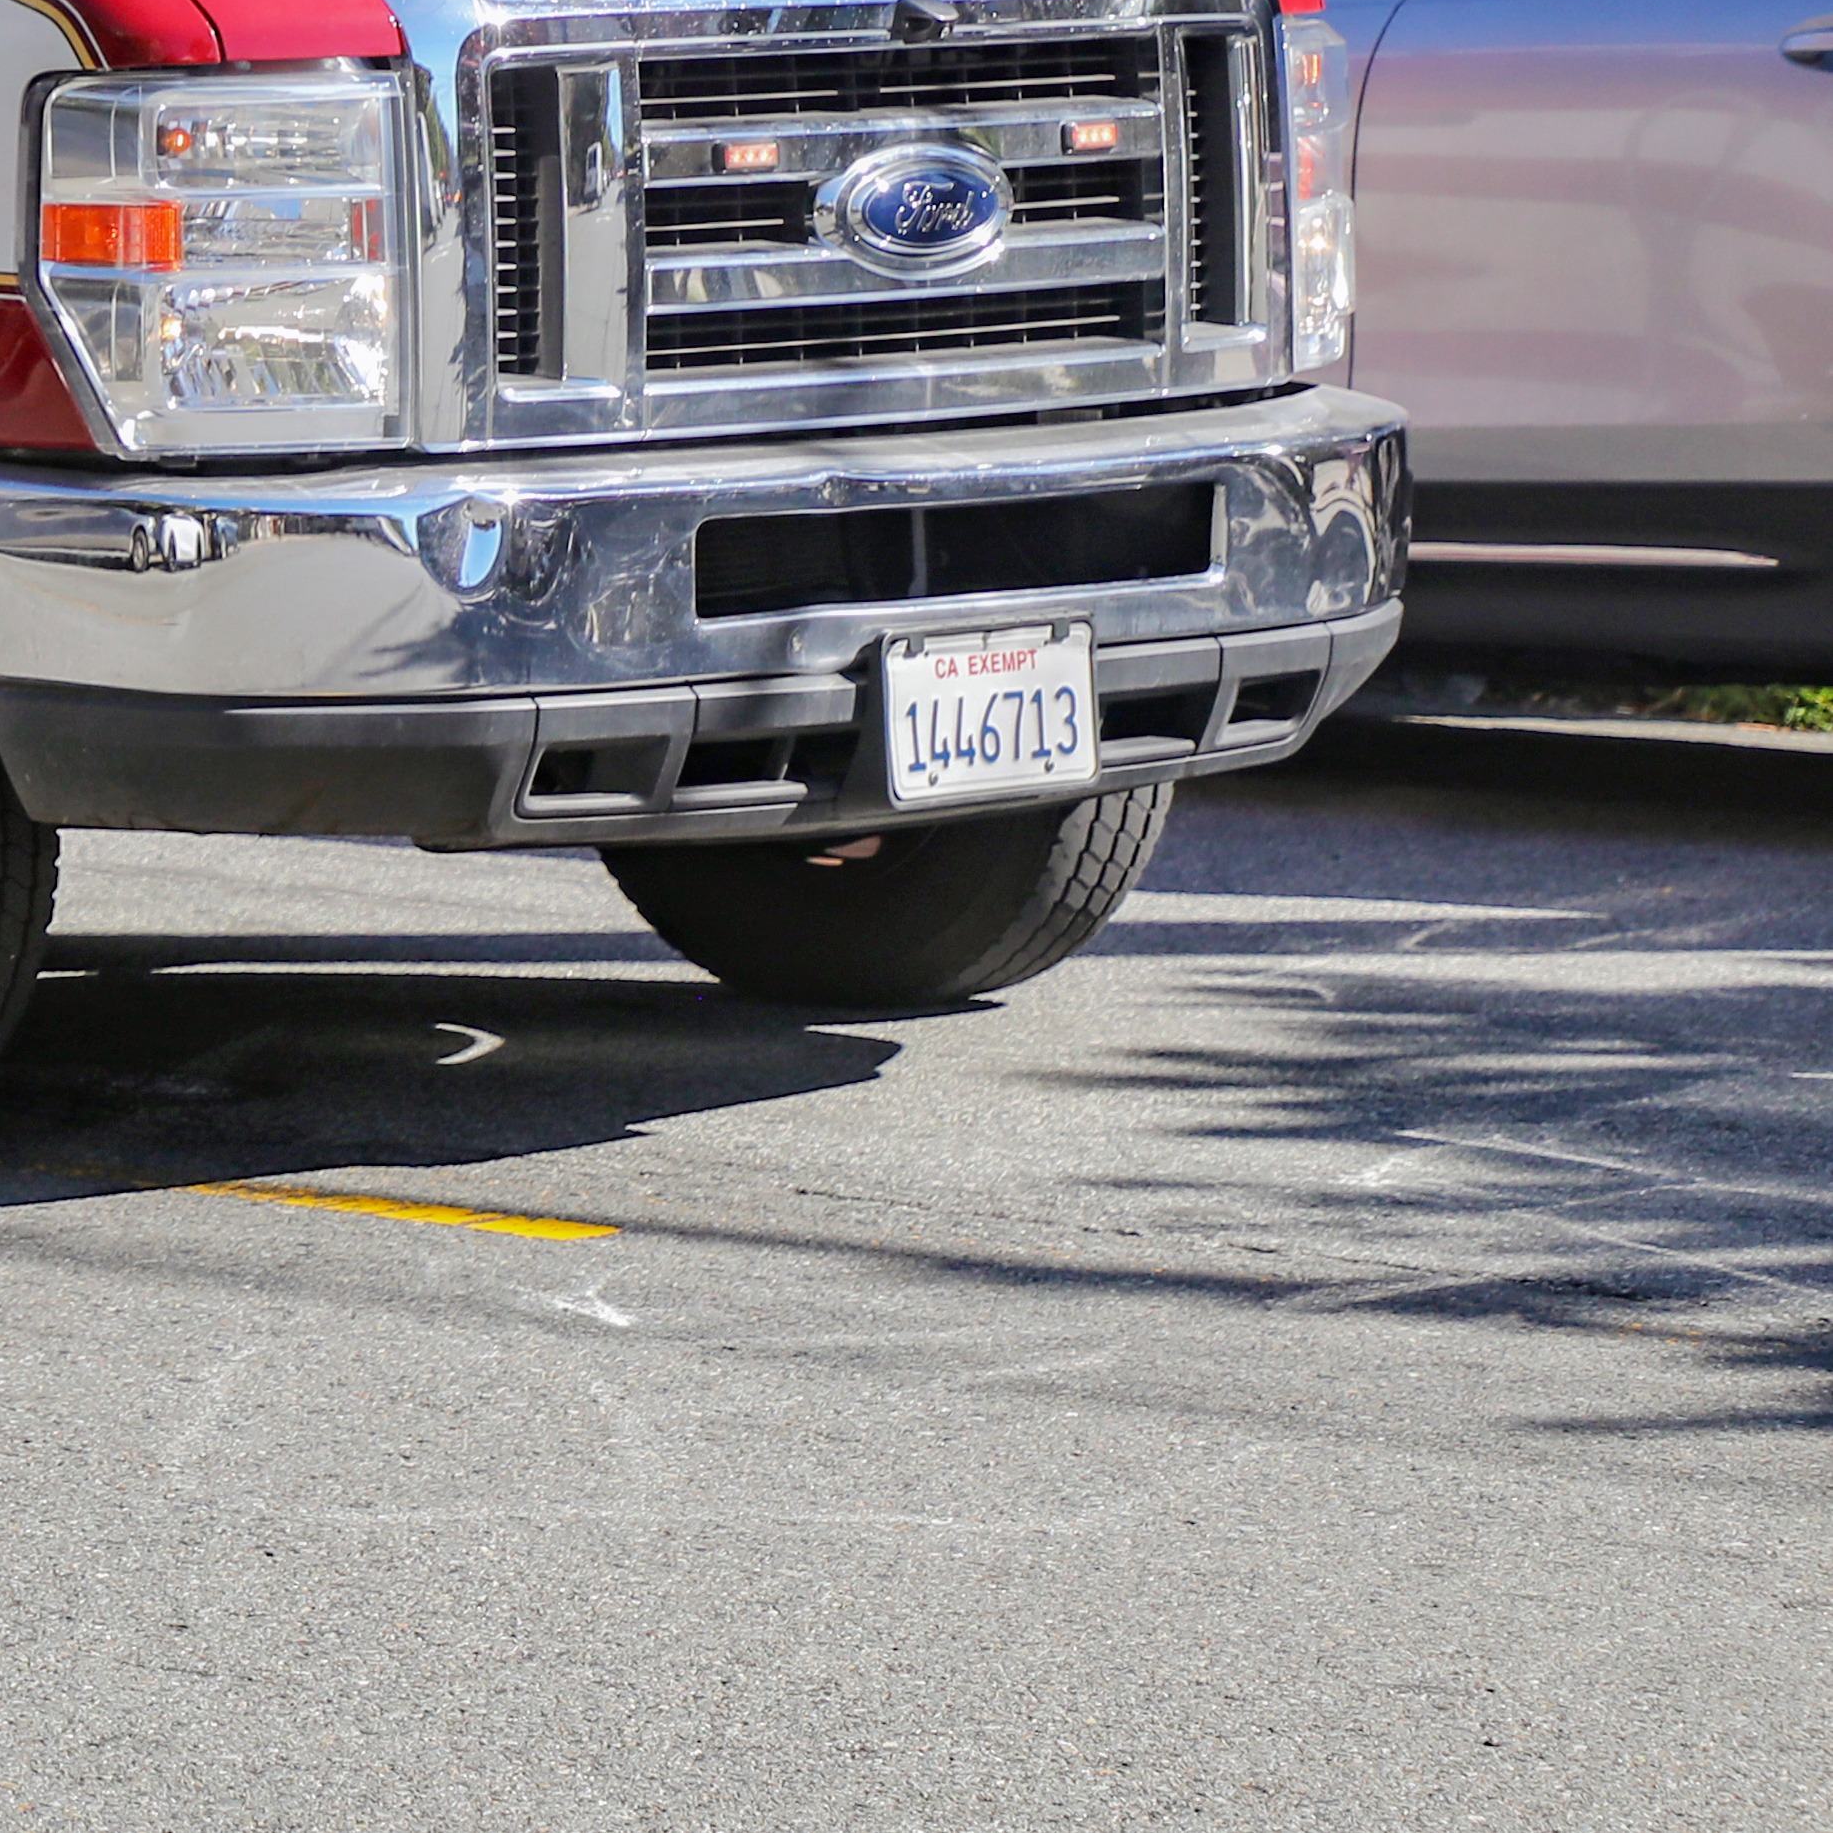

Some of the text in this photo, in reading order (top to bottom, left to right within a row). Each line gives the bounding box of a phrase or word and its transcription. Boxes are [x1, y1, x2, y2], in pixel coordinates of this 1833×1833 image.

[894, 180, 973, 236] Ford
[935, 648, 1039, 679] CA EXEMPT
[906, 685, 1078, 773] 1446713
